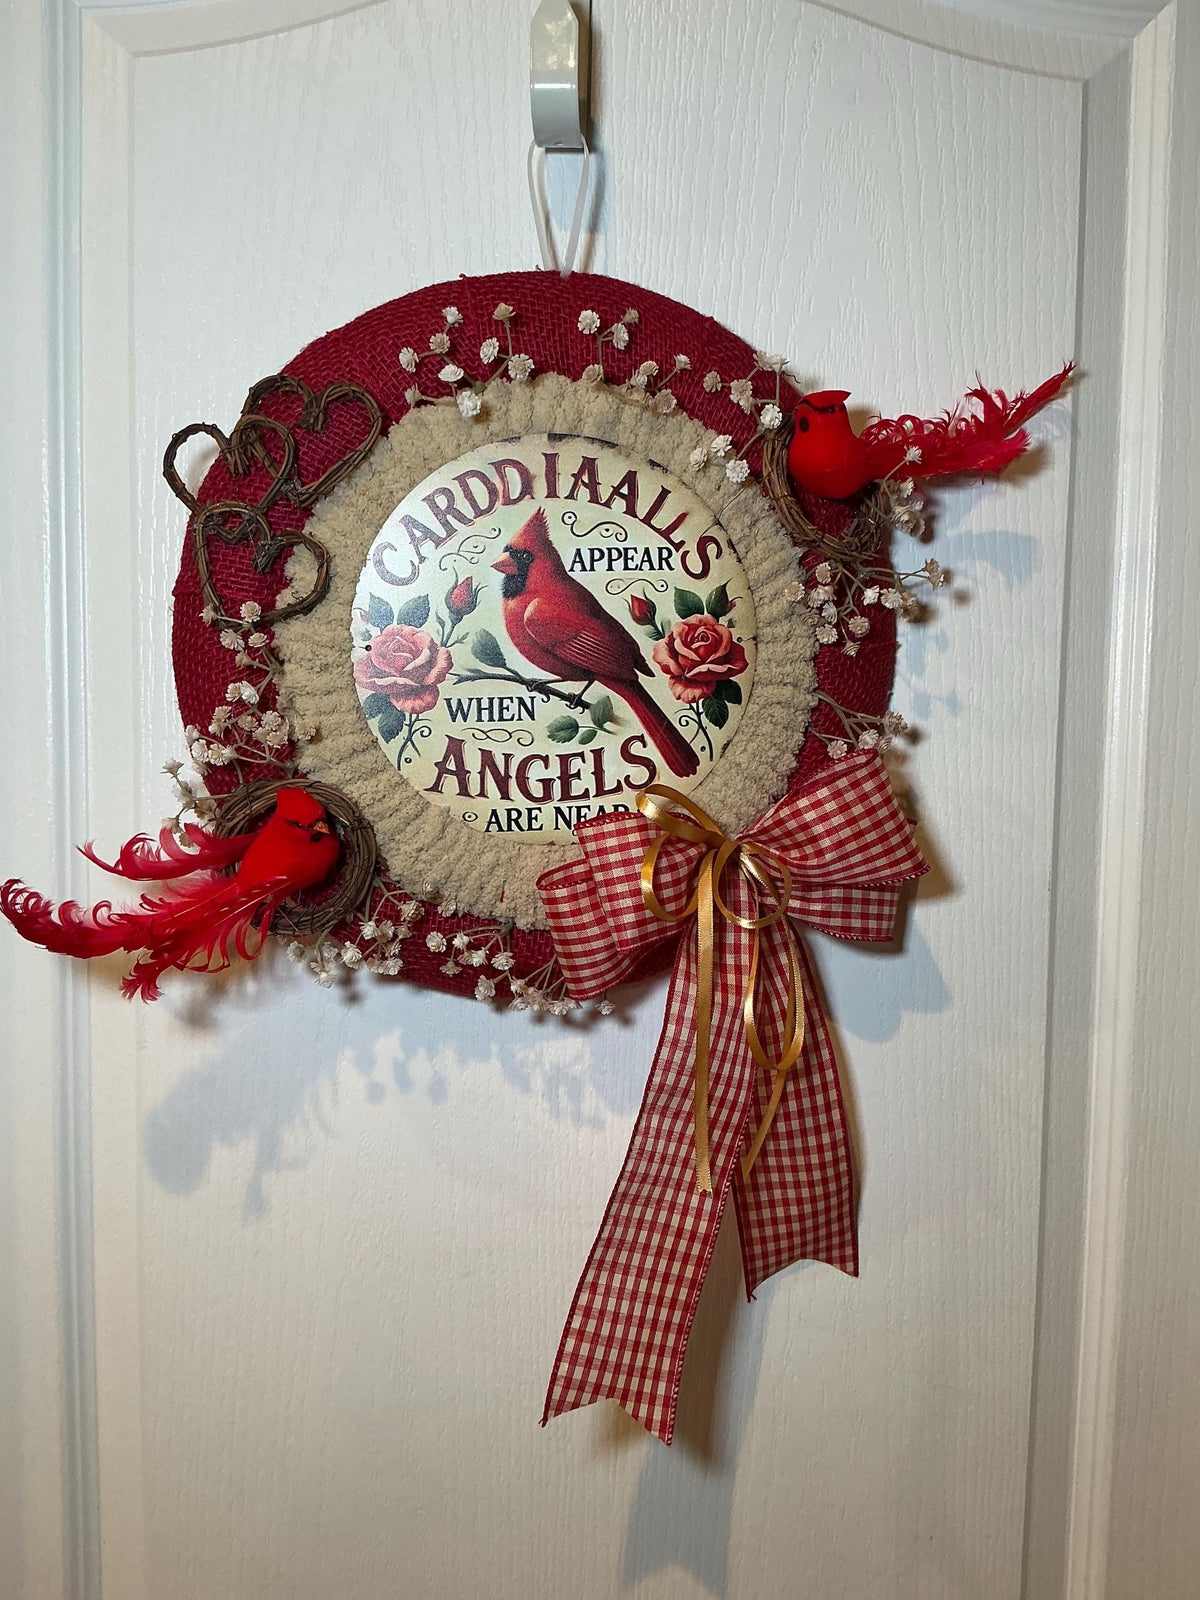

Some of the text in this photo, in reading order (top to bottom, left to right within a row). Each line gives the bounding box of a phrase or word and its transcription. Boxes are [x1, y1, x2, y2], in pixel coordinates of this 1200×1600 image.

[568, 546, 675, 572] APPEAR
[444, 696, 537, 723] WHEN
[423, 733, 658, 804] ANGELS
[484, 807, 544, 832] ARE
